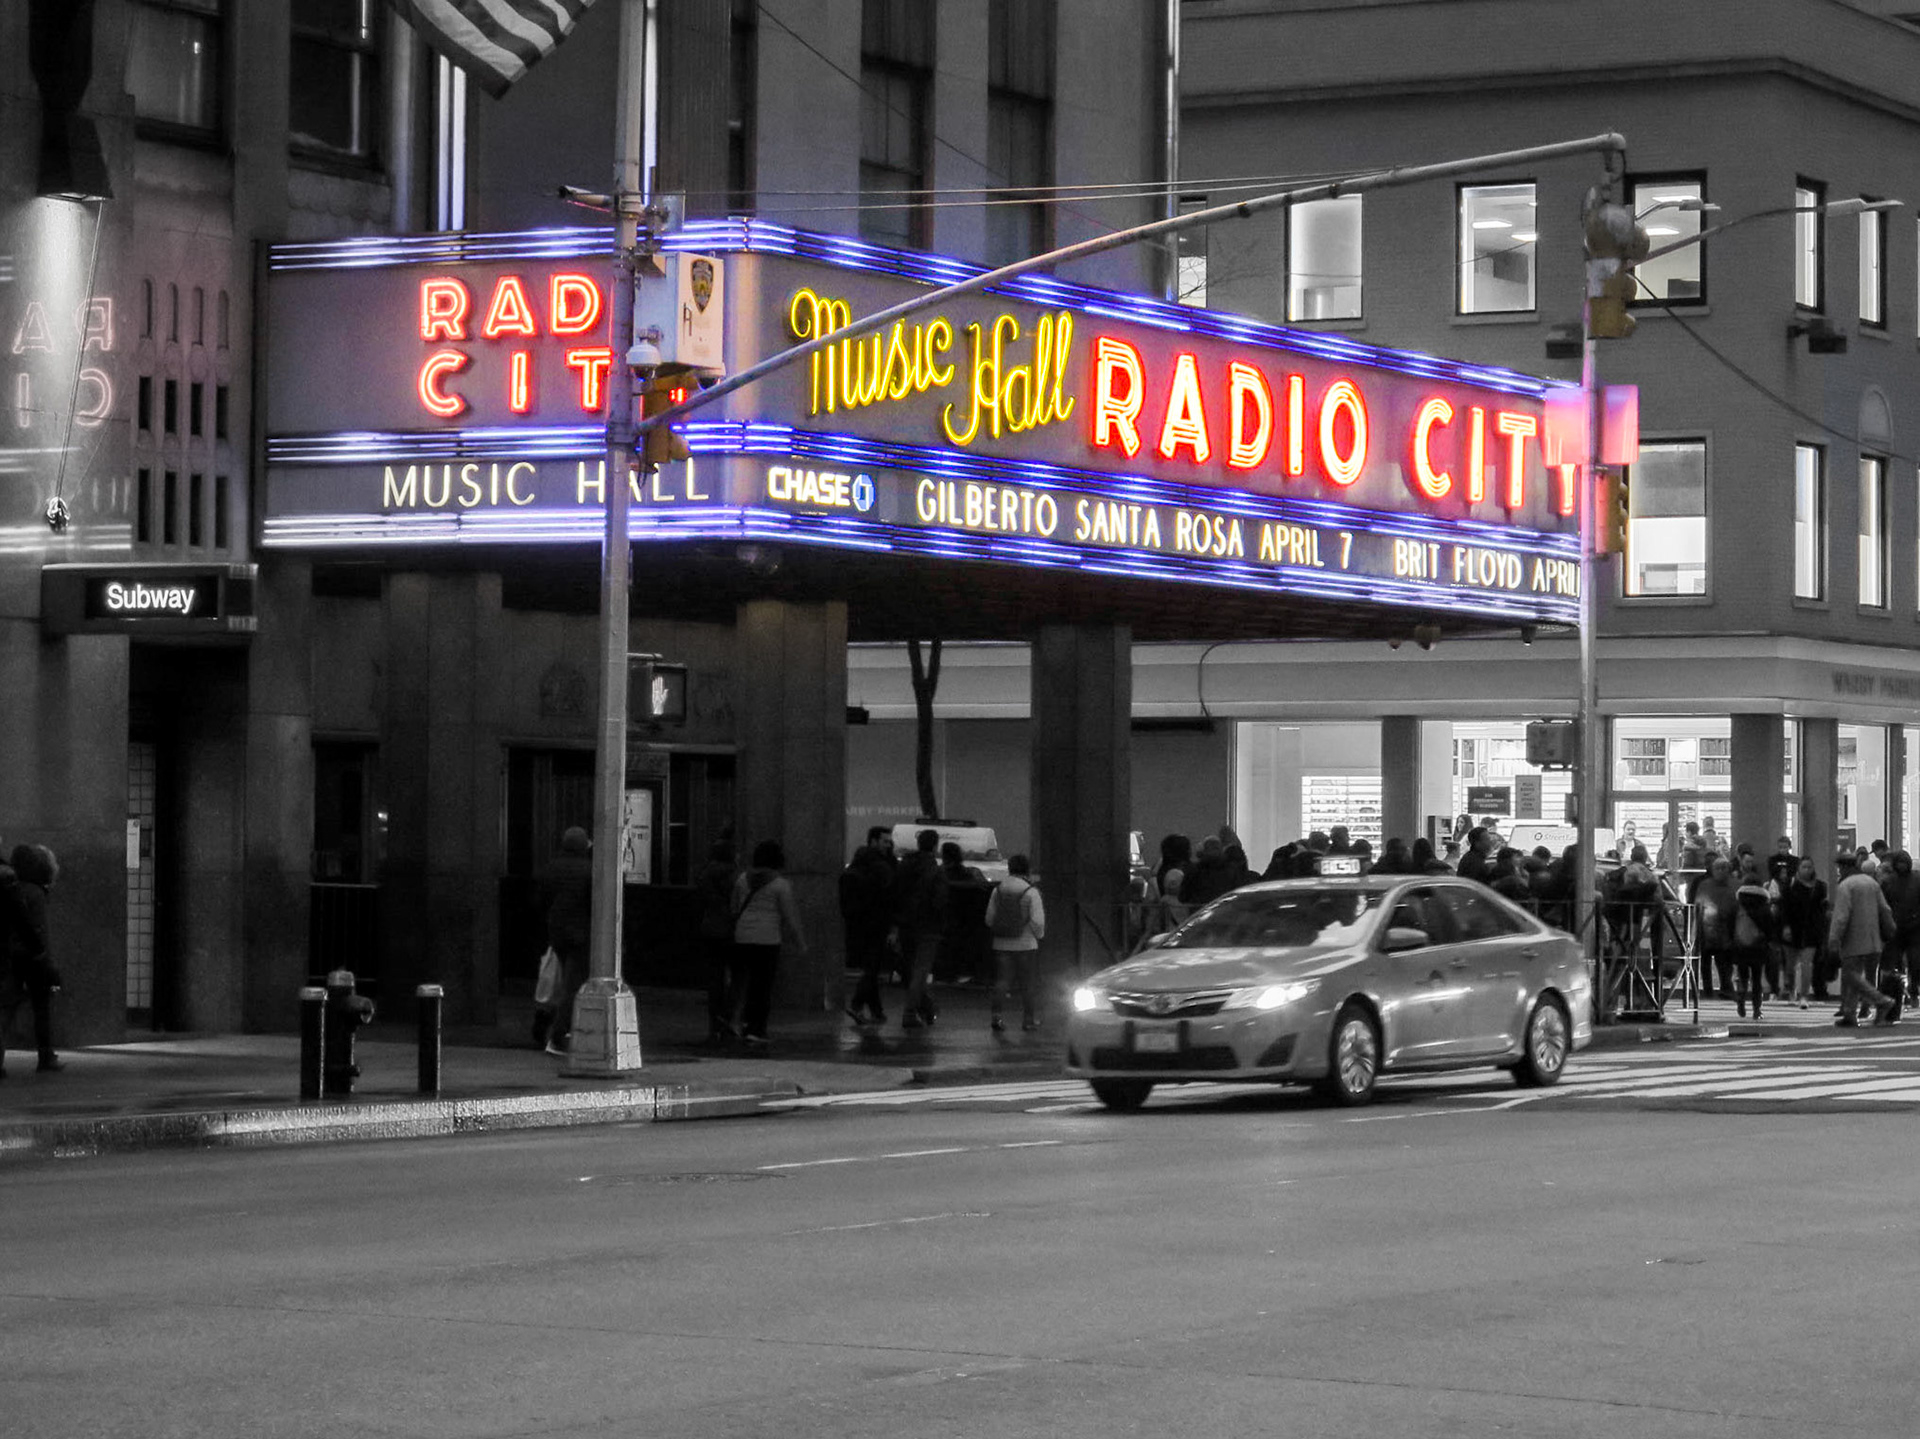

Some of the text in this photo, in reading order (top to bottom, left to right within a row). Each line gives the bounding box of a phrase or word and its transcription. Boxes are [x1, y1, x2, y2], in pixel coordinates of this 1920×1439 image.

[419, 274, 604, 341] RAD
[417, 346, 612, 417] CIT
[791, 287, 1075, 446] Music Hall
[1094, 336, 1368, 486] RADIO
[383, 461, 536, 508] MUSIC
[768, 465, 852, 507] CHASE
[917, 478, 1058, 536] GILBERTO
[1075, 499, 1161, 549] SANTA
[1175, 512, 1245, 557] ROSA
[1259, 522, 1324, 568] APRIL
[1339, 532, 1353, 570] 7
[1394, 538, 1440, 580] BRIT
[1453, 545, 1522, 590] FLOYD
[106, 582, 194, 613] Subway
